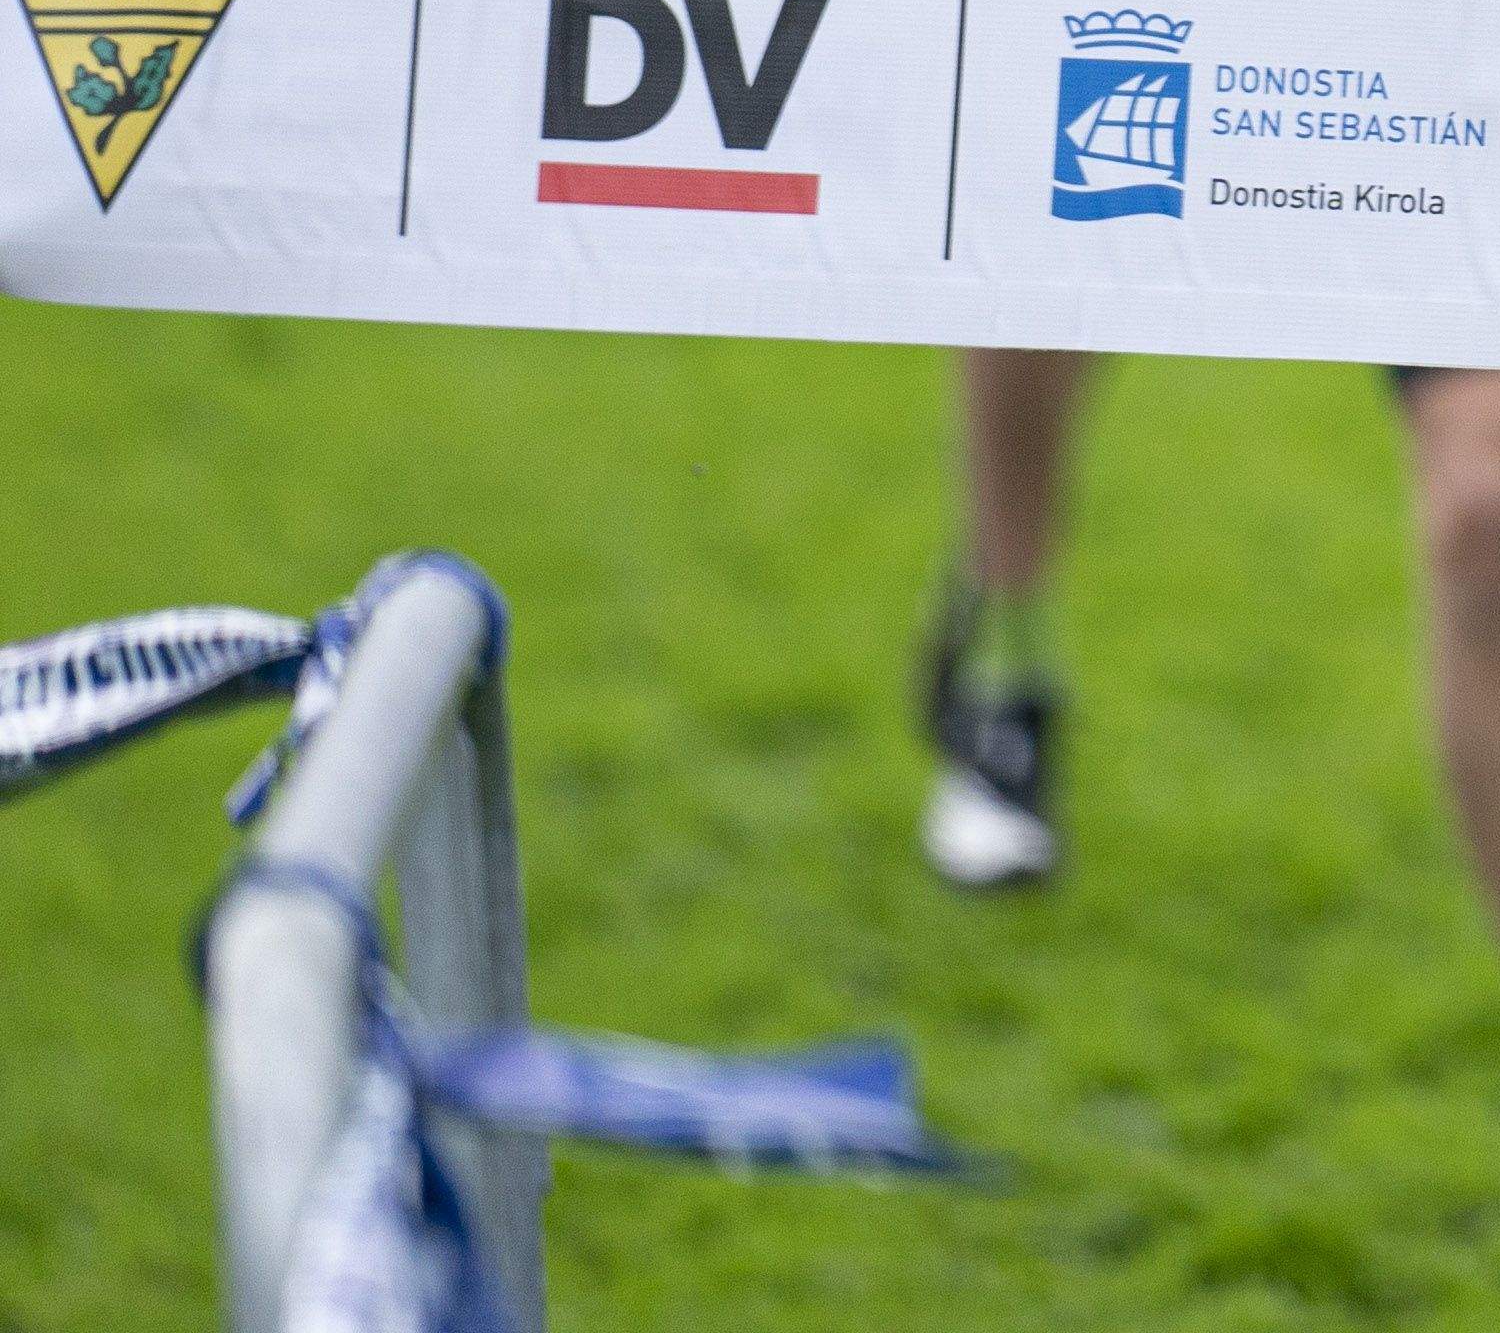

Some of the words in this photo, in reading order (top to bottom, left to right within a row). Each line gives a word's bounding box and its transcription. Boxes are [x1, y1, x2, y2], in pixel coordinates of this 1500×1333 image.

[1216, 64, 1388, 100] DONOSTIA
[1211, 107, 1281, 138] SAN
[1295, 109, 1487, 147] SEBASTIÁN
[1210, 177, 1344, 212] Donostia
[1353, 183, 1445, 216] Kirola
